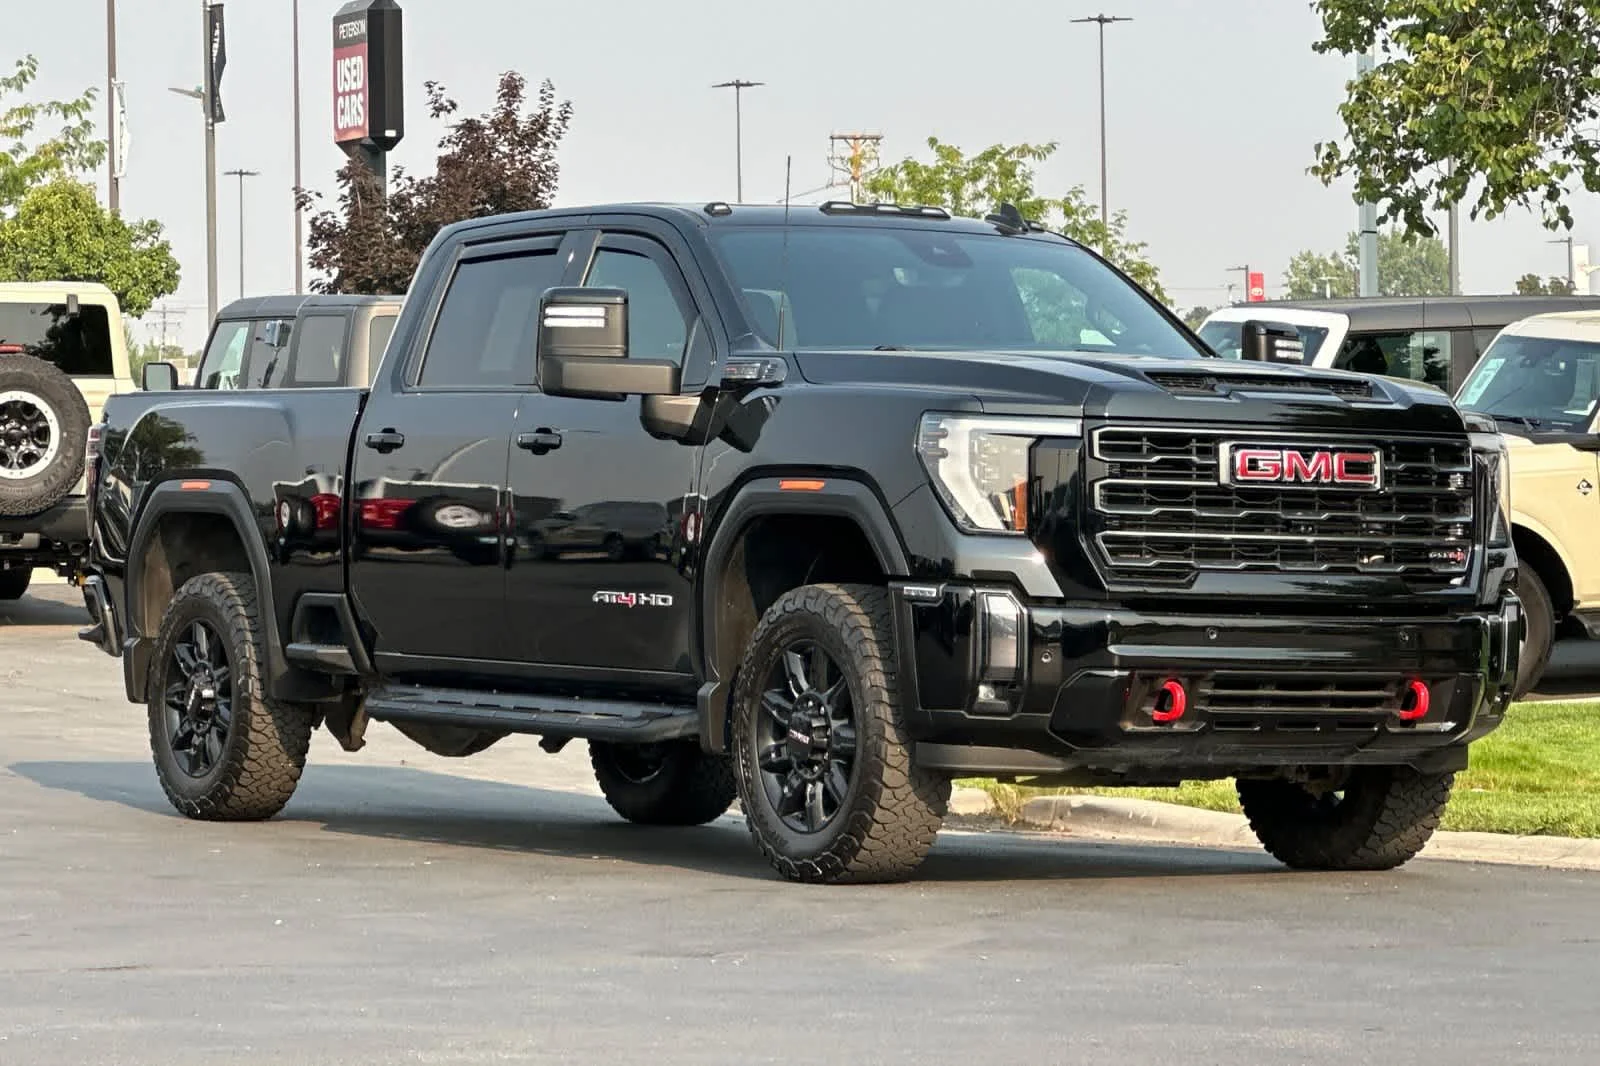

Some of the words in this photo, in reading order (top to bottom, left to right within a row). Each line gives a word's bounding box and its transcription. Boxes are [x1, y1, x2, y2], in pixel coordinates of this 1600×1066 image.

[339, 19, 366, 39] PETERSON
[337, 55, 364, 93] USED
[337, 92, 364, 129] CARS
[1236, 450, 1376, 483] GMC
